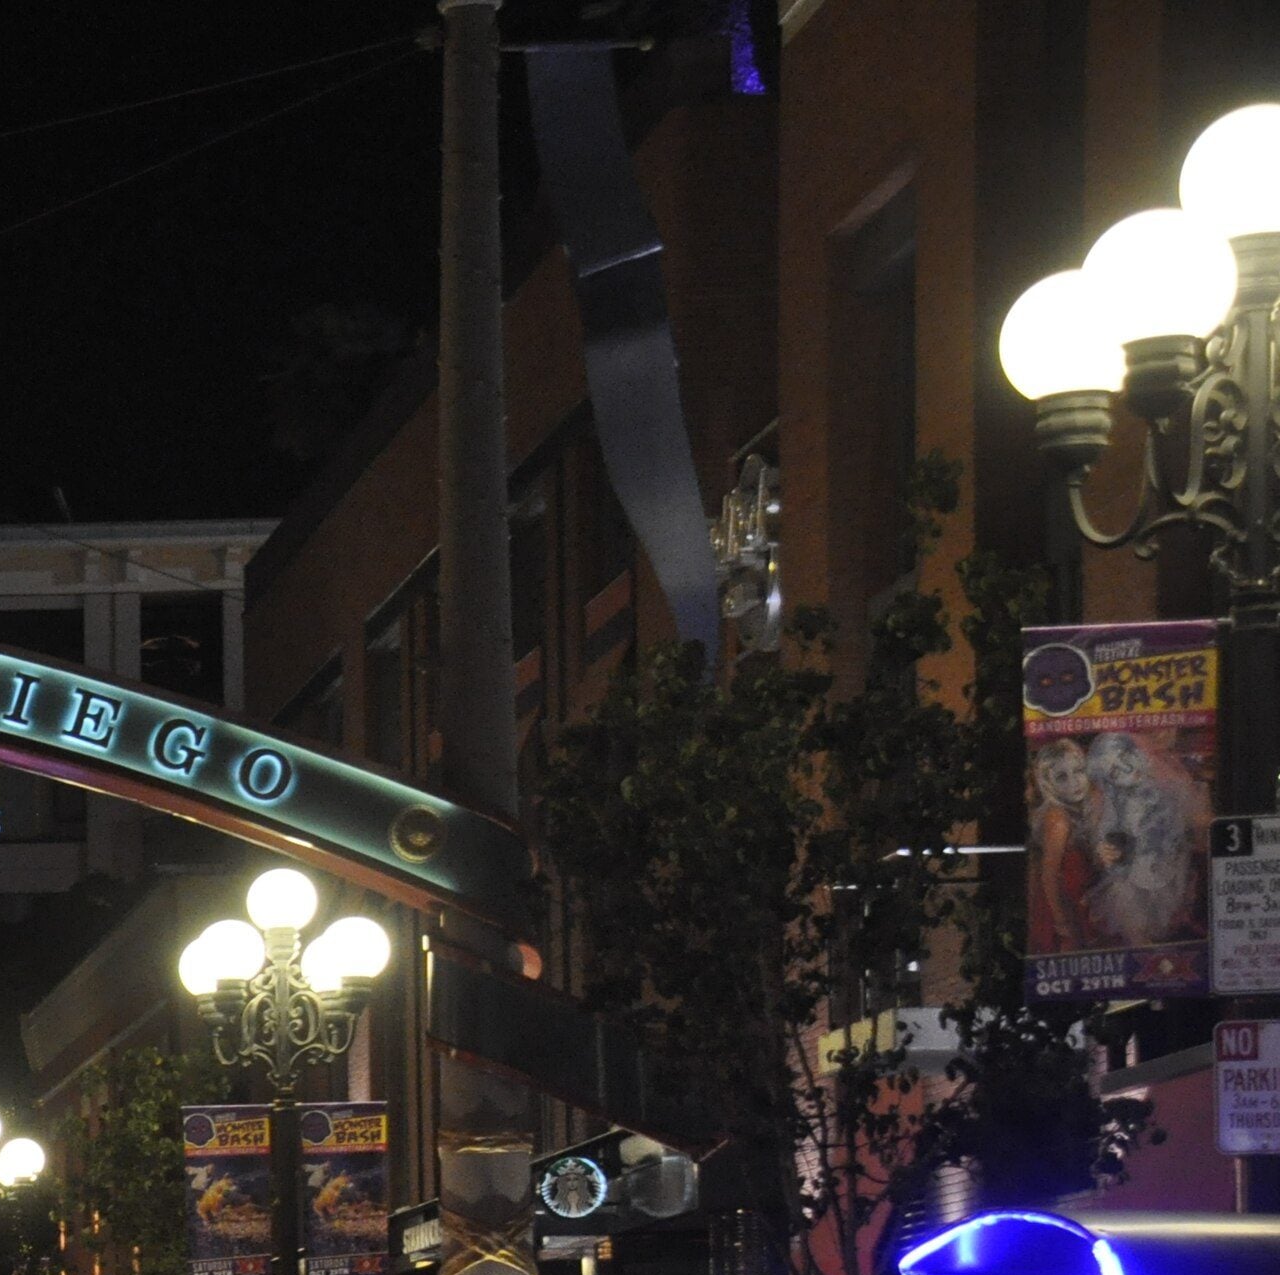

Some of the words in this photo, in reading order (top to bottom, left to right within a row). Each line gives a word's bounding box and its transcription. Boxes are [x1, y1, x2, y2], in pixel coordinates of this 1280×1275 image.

[1096, 655, 1208, 686] MONSTER
[1101, 681, 1206, 712] BASH
[1225, 823, 1240, 853] 3
[1035, 953, 1127, 980] SATURDAY
[1035, 978, 1072, 997] OCT
[1080, 974, 1127, 992] 29TH
[1221, 1027, 1253, 1058] NO
[218, 1132, 265, 1147] BASH
[335, 1129, 382, 1143] BASH
